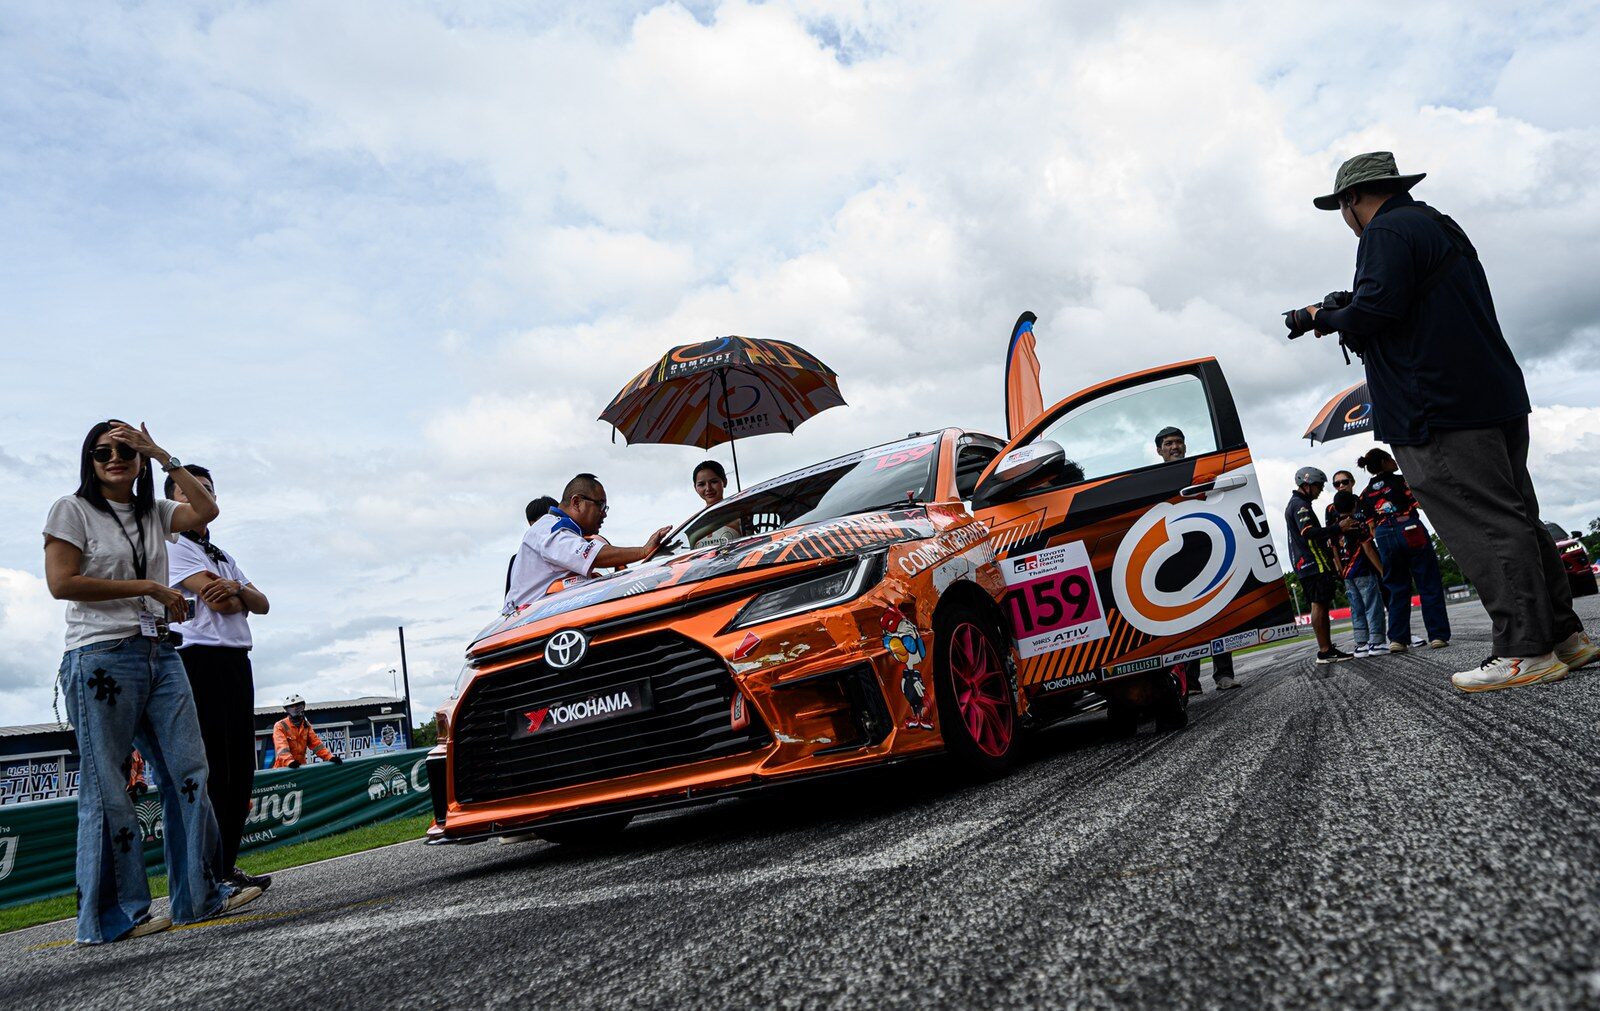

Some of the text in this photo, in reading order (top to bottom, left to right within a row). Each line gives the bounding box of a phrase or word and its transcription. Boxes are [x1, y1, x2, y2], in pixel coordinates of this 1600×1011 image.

[670, 353, 731, 371] COMPACT
[873, 443, 936, 471] 159
[1039, 548, 1066, 558] TOYOTA
[1039, 553, 1064, 563] GAZOO
[1014, 559, 1038, 574] GR
[1028, 566, 1058, 577] Thailand
[1002, 574, 1091, 632] 159
[1053, 626, 1089, 643] ATIV
[1164, 647, 1209, 664] LENSO
[1117, 656, 1159, 674] MODELLISTA
[1043, 671, 1097, 691] YOKOHAMA
[549, 691, 632, 724] YOKOHAMA
[40, 763, 59, 774] KM
